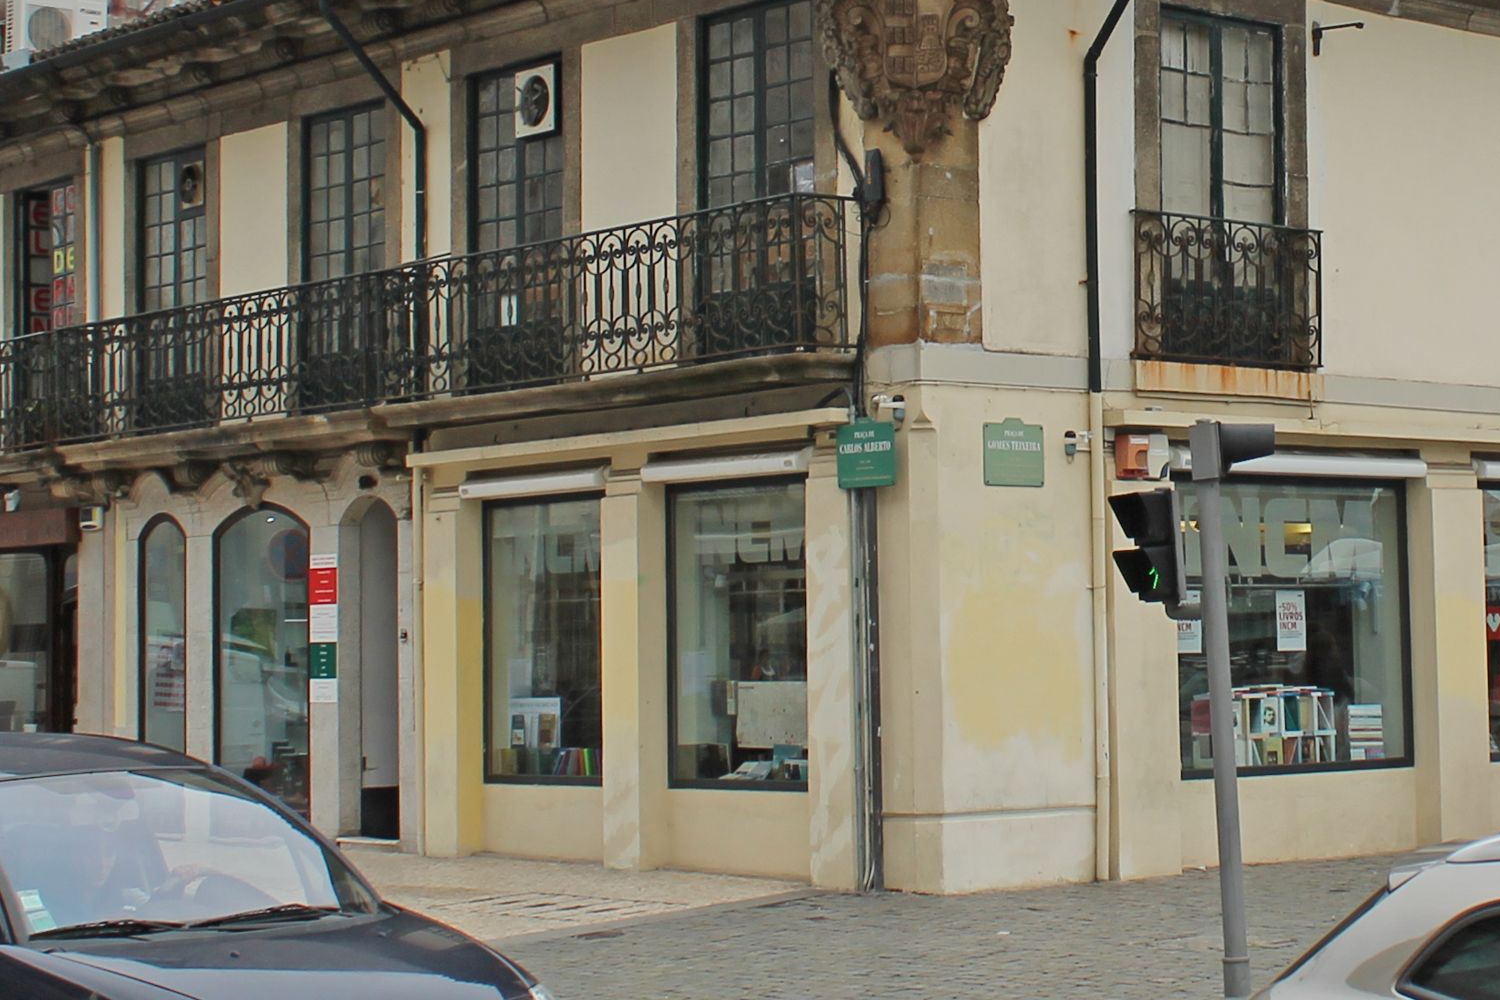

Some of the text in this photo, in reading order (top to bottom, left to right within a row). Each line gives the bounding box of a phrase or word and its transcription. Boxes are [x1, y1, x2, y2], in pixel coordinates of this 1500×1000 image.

[839, 440, 891, 454] CARLOS ALBERTO
[987, 440, 1041, 451] GOMES TEIXEIRA
[1279, 611, 1304, 621] LIVROS
[1279, 621, 1297, 630] INCM
